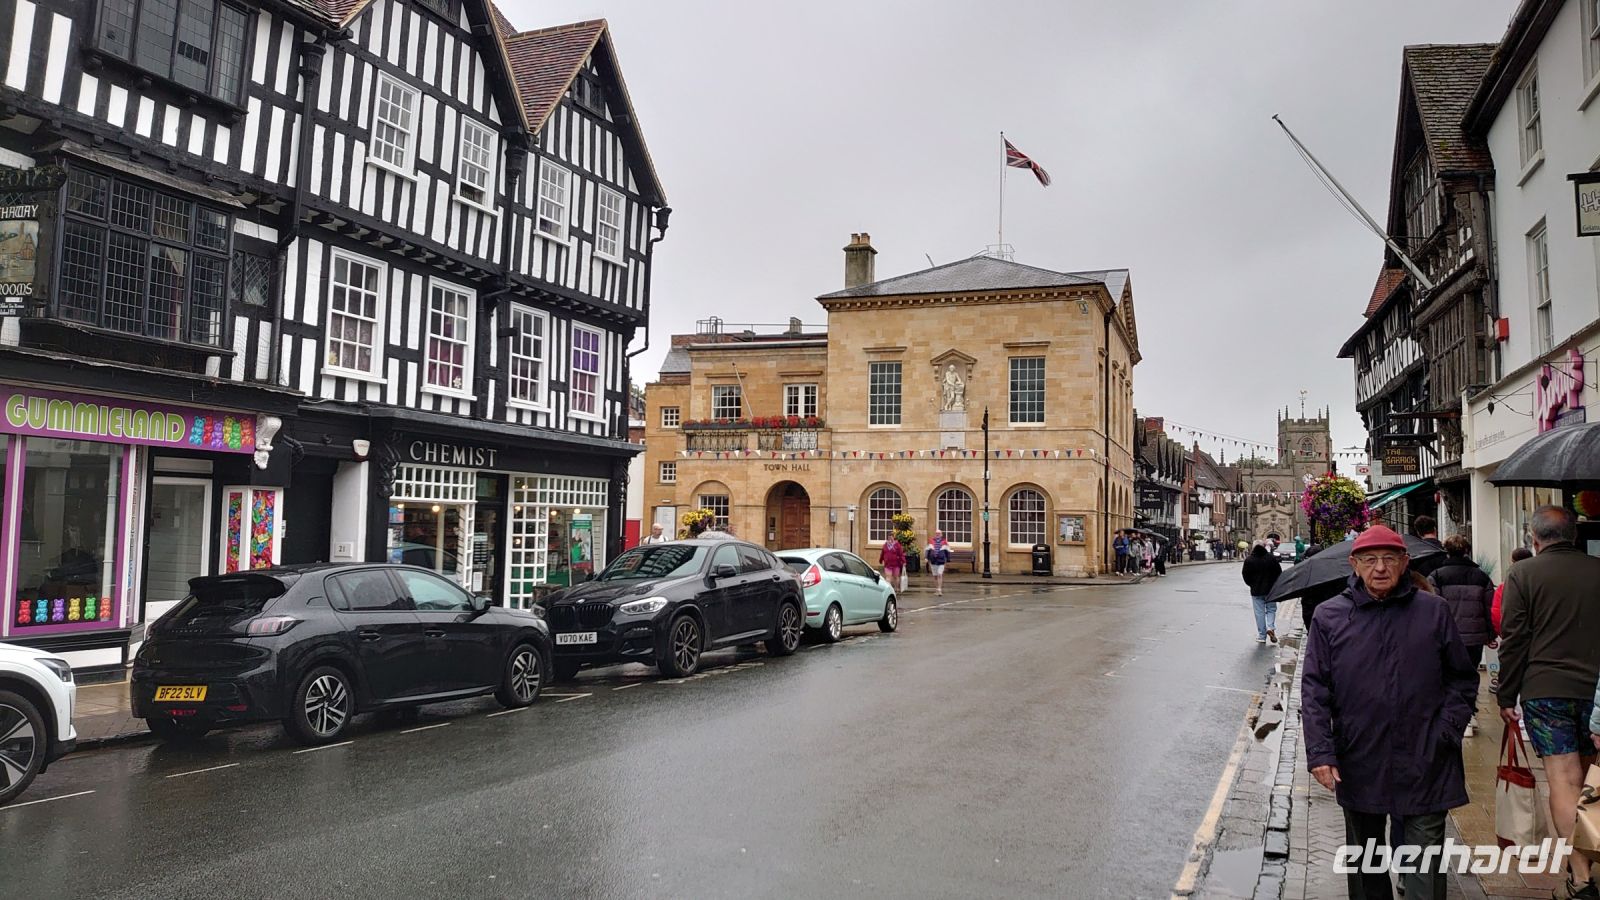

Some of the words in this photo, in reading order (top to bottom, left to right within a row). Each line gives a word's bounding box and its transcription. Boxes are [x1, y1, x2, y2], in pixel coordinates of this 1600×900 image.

[5, 393, 186, 443] GUMMIELAND
[409, 440, 497, 467] CHEMIST
[1385, 456, 1416, 465] GARRICK
[763, 463, 788, 471] TOWN
[791, 463, 811, 471] HALL
[578, 633, 594, 642] KAE
[158, 687, 181, 699] BF22
[183, 687, 203, 699] SLV
